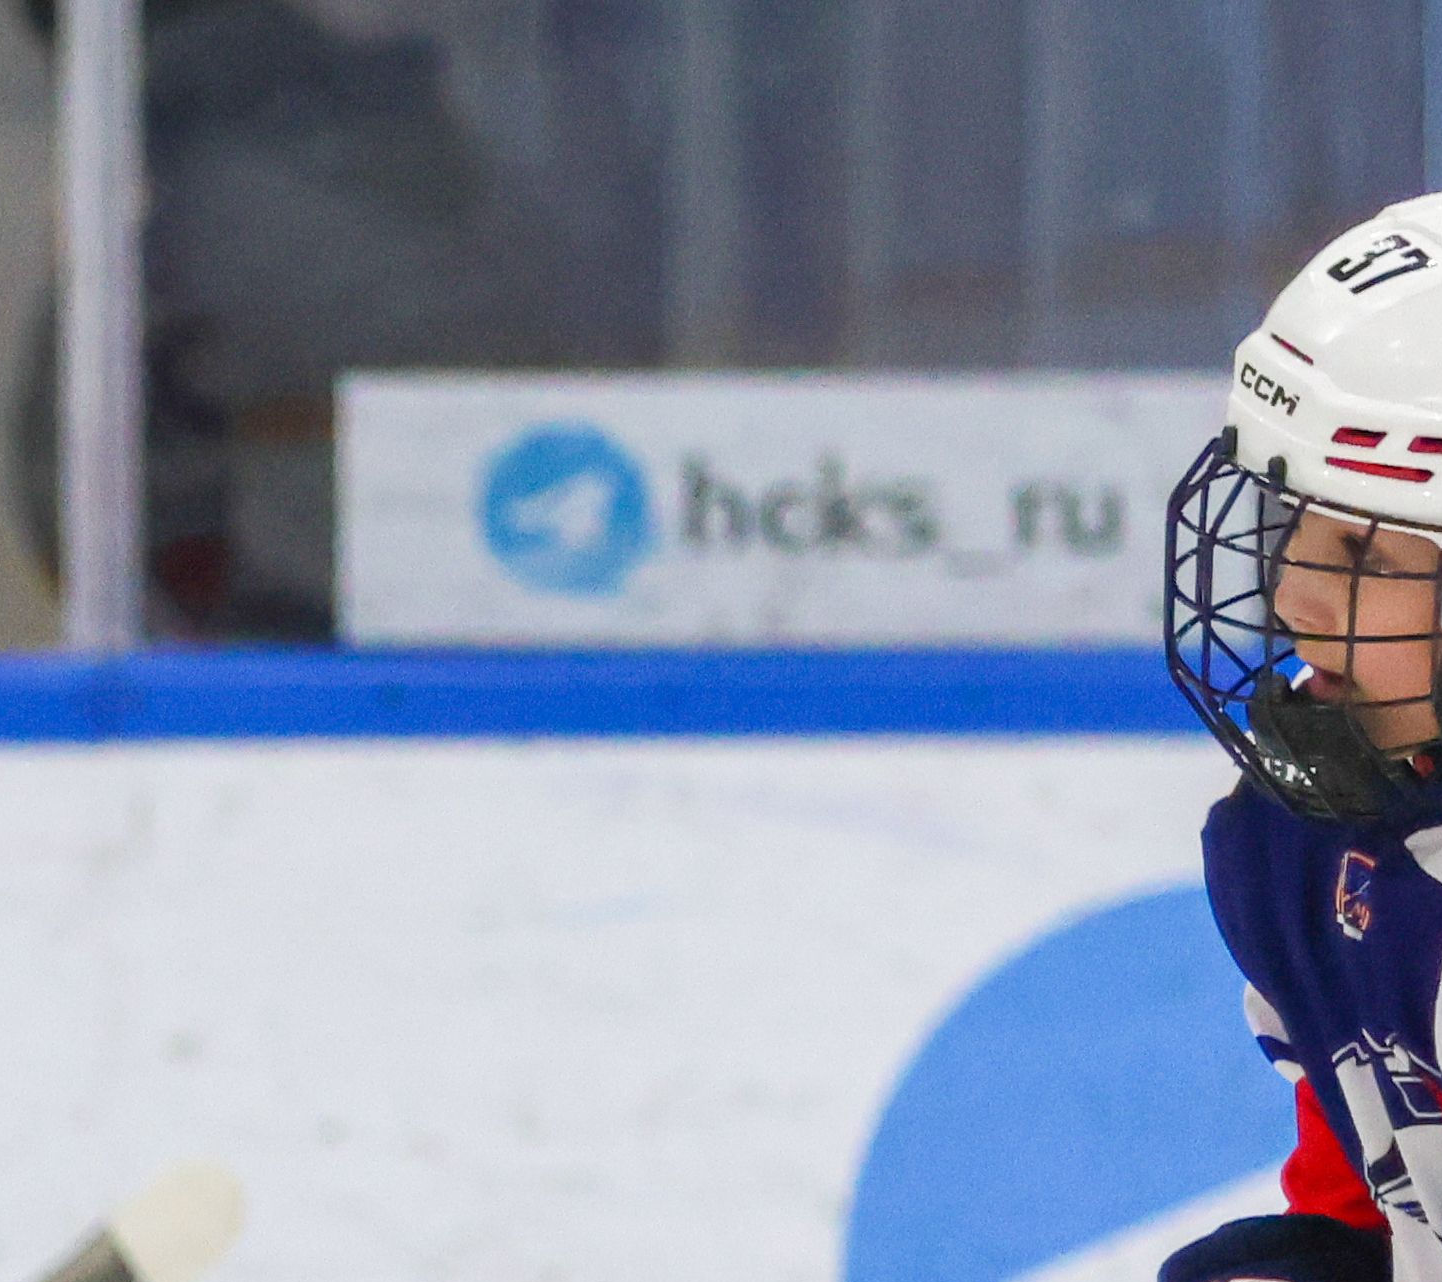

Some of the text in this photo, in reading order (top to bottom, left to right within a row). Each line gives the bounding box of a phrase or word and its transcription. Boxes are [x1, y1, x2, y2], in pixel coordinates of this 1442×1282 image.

[1326, 234, 1438, 294] 37
[1240, 362, 1300, 417] CCM
[679, 446, 1128, 578] hcks_ru
